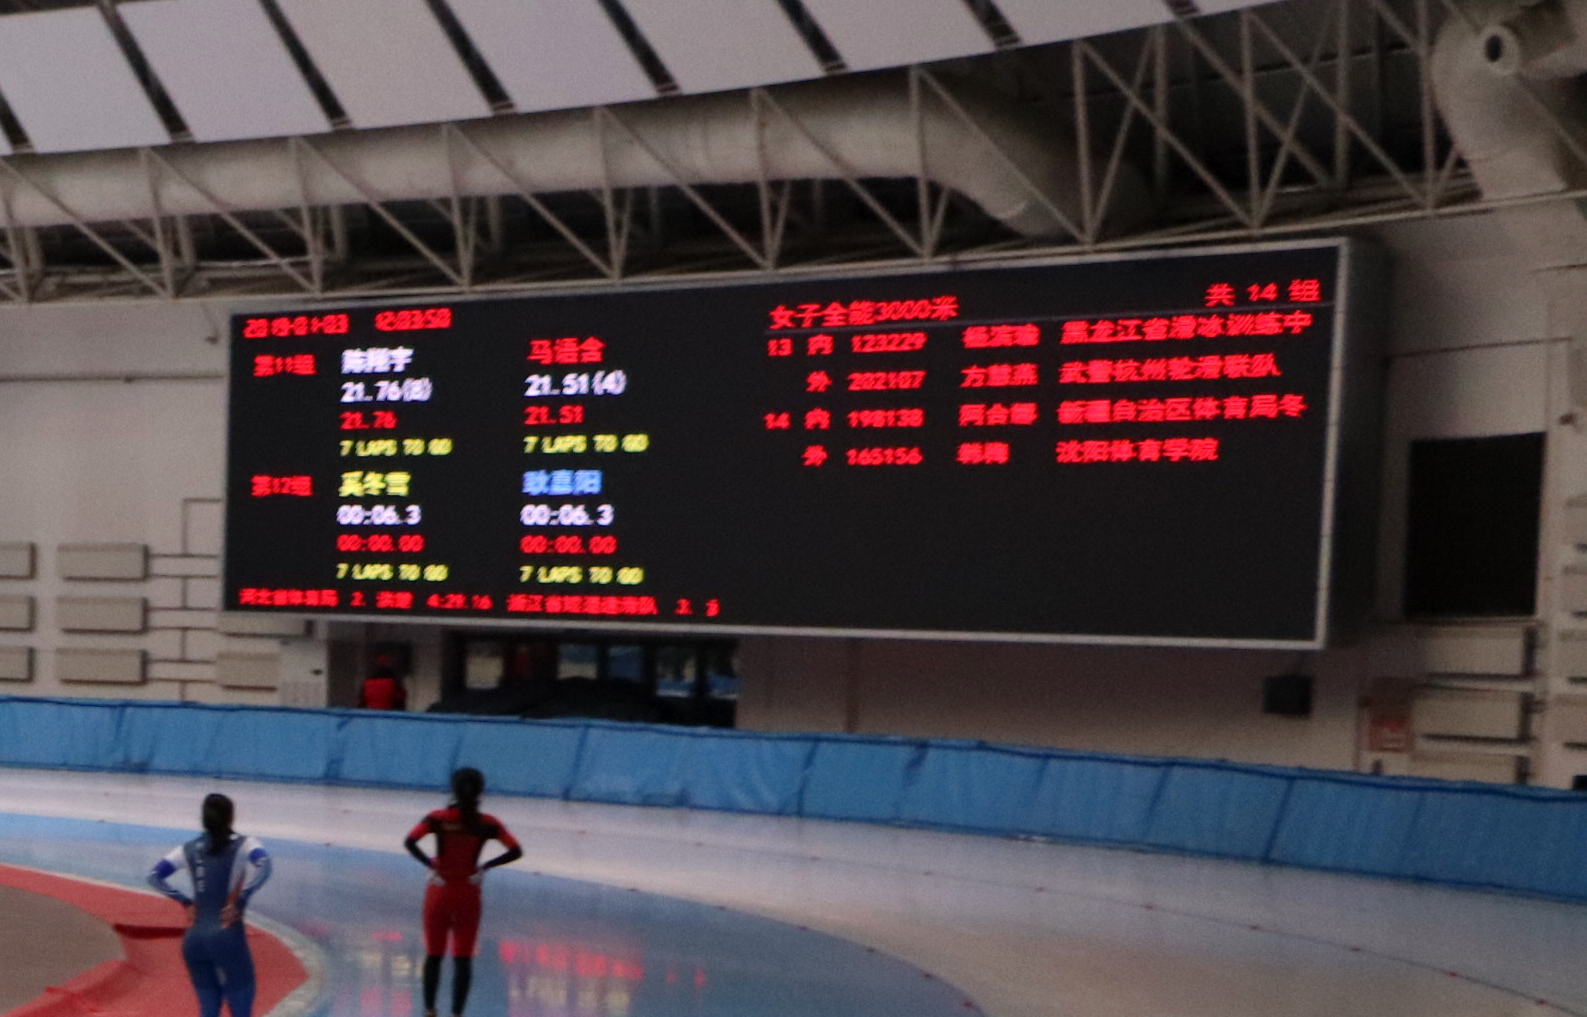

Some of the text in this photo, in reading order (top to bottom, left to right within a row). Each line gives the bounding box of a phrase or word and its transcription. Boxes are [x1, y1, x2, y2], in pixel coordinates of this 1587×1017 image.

[1205, 279, 1321, 307] 共 14 组
[769, 295, 958, 330] 女子全能3000米
[767, 337, 794, 357] 13
[524, 370, 626, 397] 21.51(4)
[340, 411, 397, 430] 21.76
[524, 405, 584, 425] 21.51
[764, 412, 791, 430] 14
[340, 438, 452, 456] 7 LAPS TO GO
[524, 434, 648, 453] 7 LAPS TO GO
[1055, 436, 1220, 464] 沈阳体育学院
[337, 505, 421, 525] 00:06.3
[520, 504, 614, 526] 00:06.3
[337, 534, 425, 552] 00:00.00
[520, 535, 617, 554] 00:00.00
[337, 563, 448, 581] 7 LAPS TO GO
[520, 566, 643, 584] 7 LAPS TO GO
